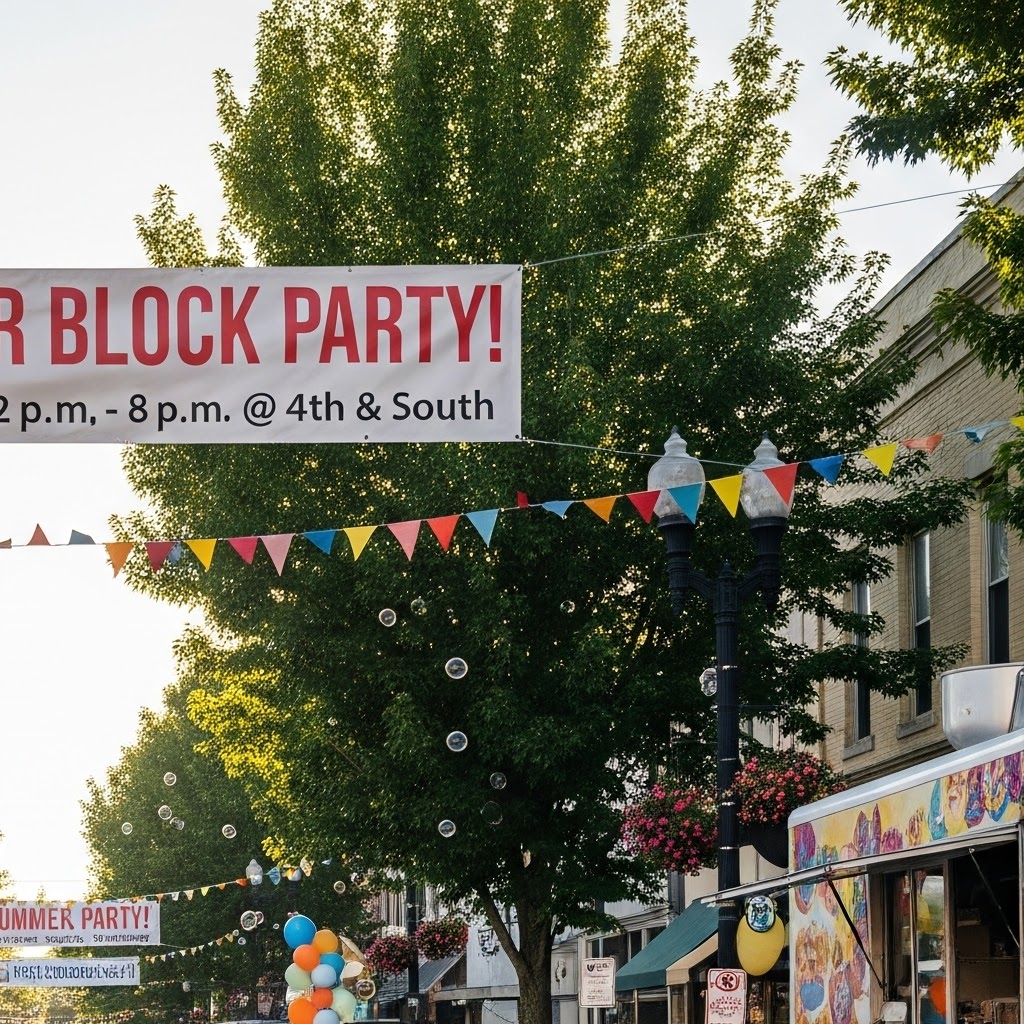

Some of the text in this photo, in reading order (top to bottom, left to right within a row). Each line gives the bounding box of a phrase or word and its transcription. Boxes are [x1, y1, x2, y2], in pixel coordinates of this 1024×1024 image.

[50, 285, 261, 367] BLOCK
[283, 284, 503, 364] PARTY!
[128, 393, 149, 424] 8
[157, 401, 231, 432] p.m.
[243, 392, 276, 427] @
[285, 391, 344, 422] 4th
[356, 392, 381, 421] &
[392, 390, 495, 422] South
[81, 905, 150, 930] PARTY!
